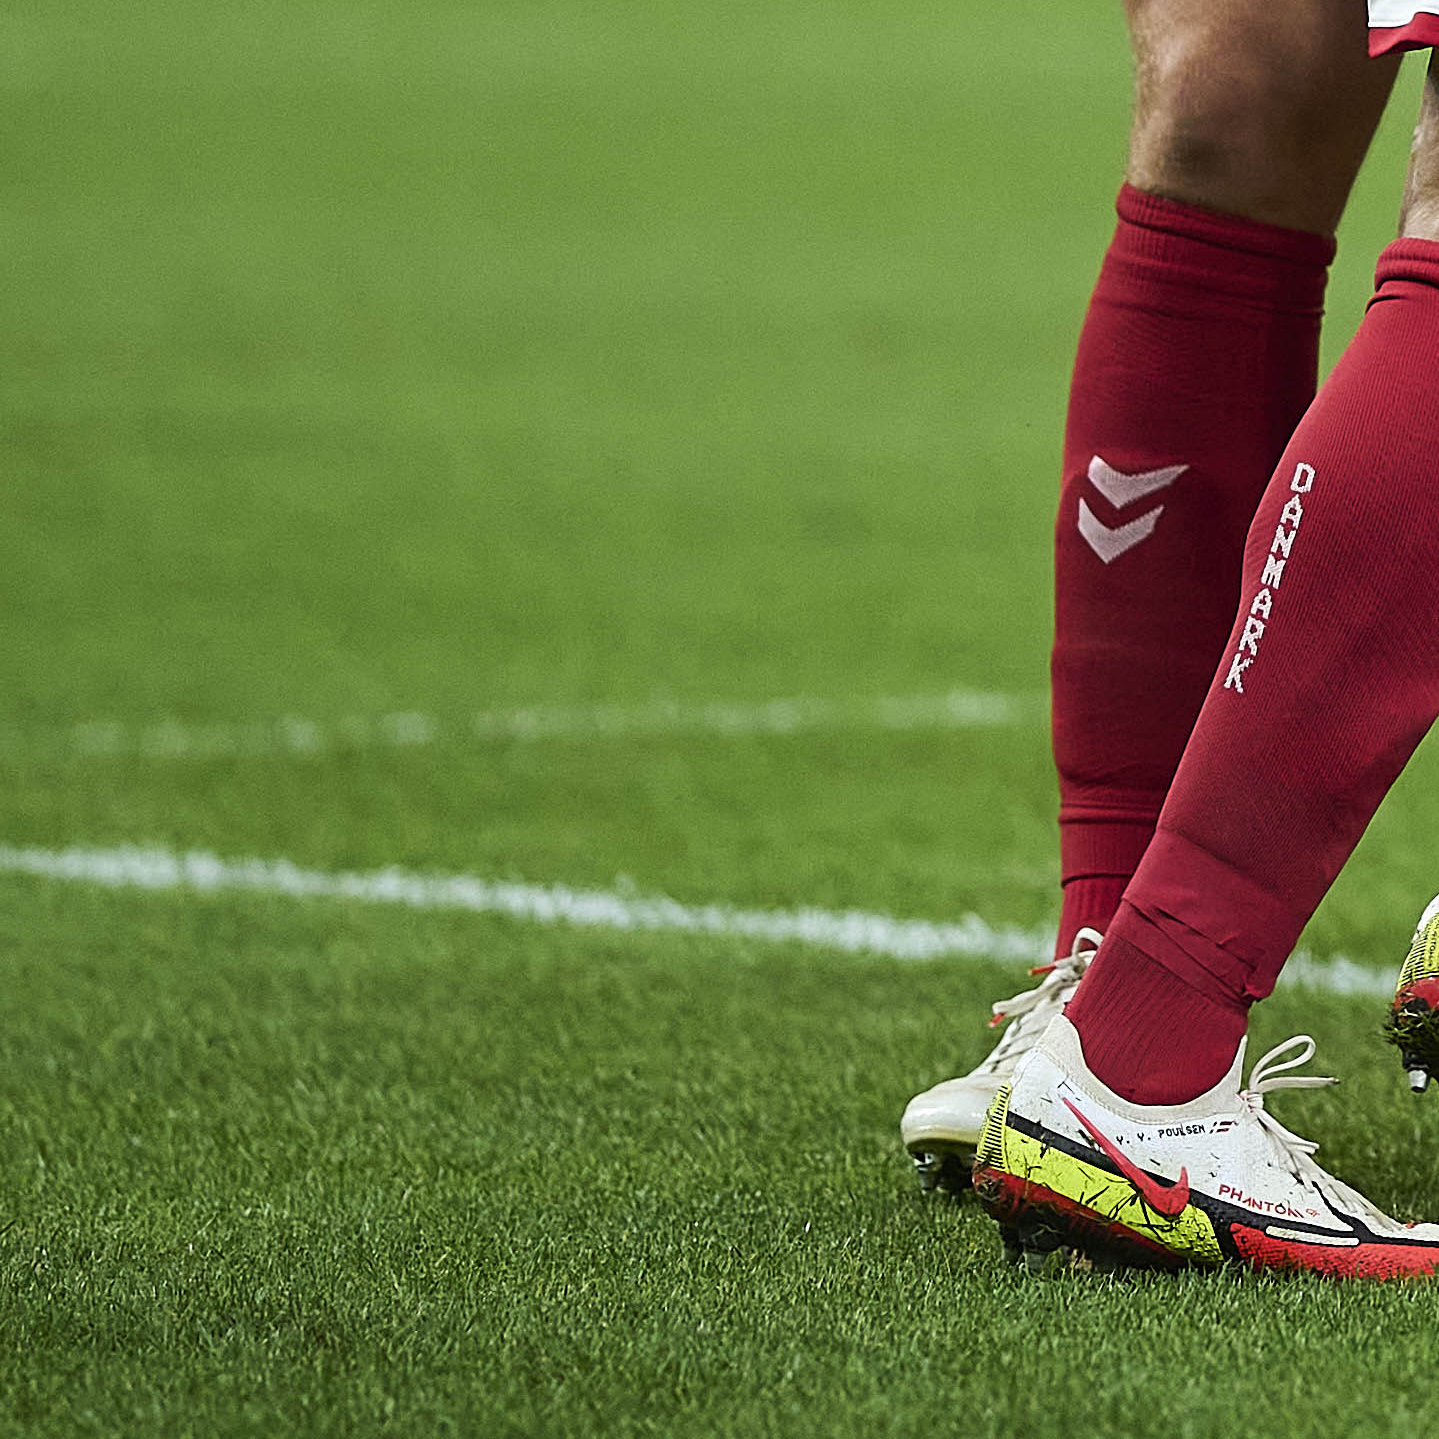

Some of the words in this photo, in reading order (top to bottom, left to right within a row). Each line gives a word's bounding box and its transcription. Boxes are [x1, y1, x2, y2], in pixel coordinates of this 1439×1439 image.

[1224, 462, 1316, 693] DANMARK
[1158, 1124, 1206, 1139] POULSEN
[1218, 1183, 1305, 1219] PHANTOM
